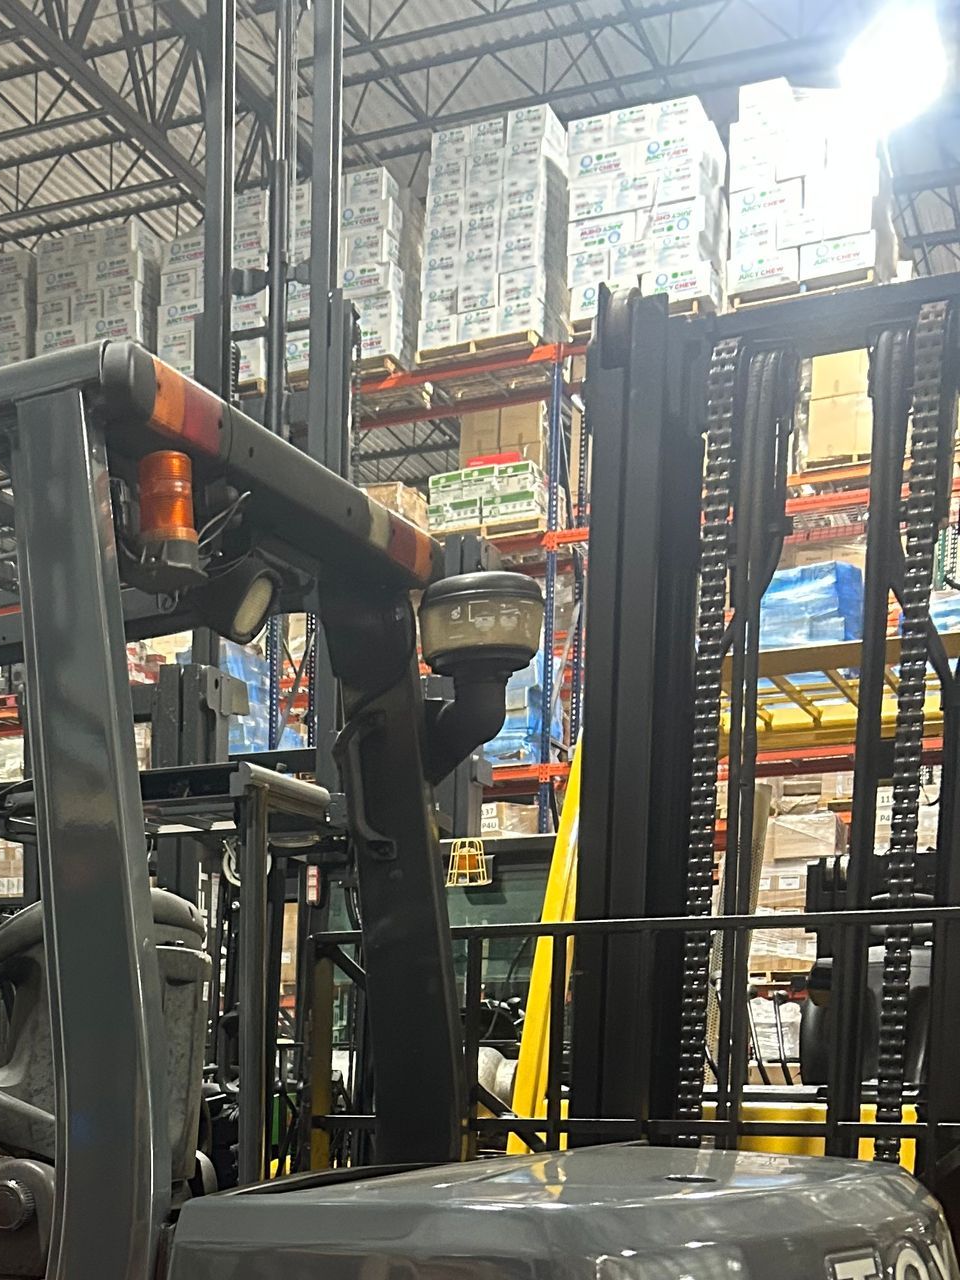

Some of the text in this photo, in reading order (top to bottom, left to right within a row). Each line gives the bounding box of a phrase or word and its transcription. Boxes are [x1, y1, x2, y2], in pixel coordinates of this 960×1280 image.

[598, 162, 621, 172] CHEW
[360, 276, 380, 285] CHEW
[674, 280, 697, 290] CHEW
